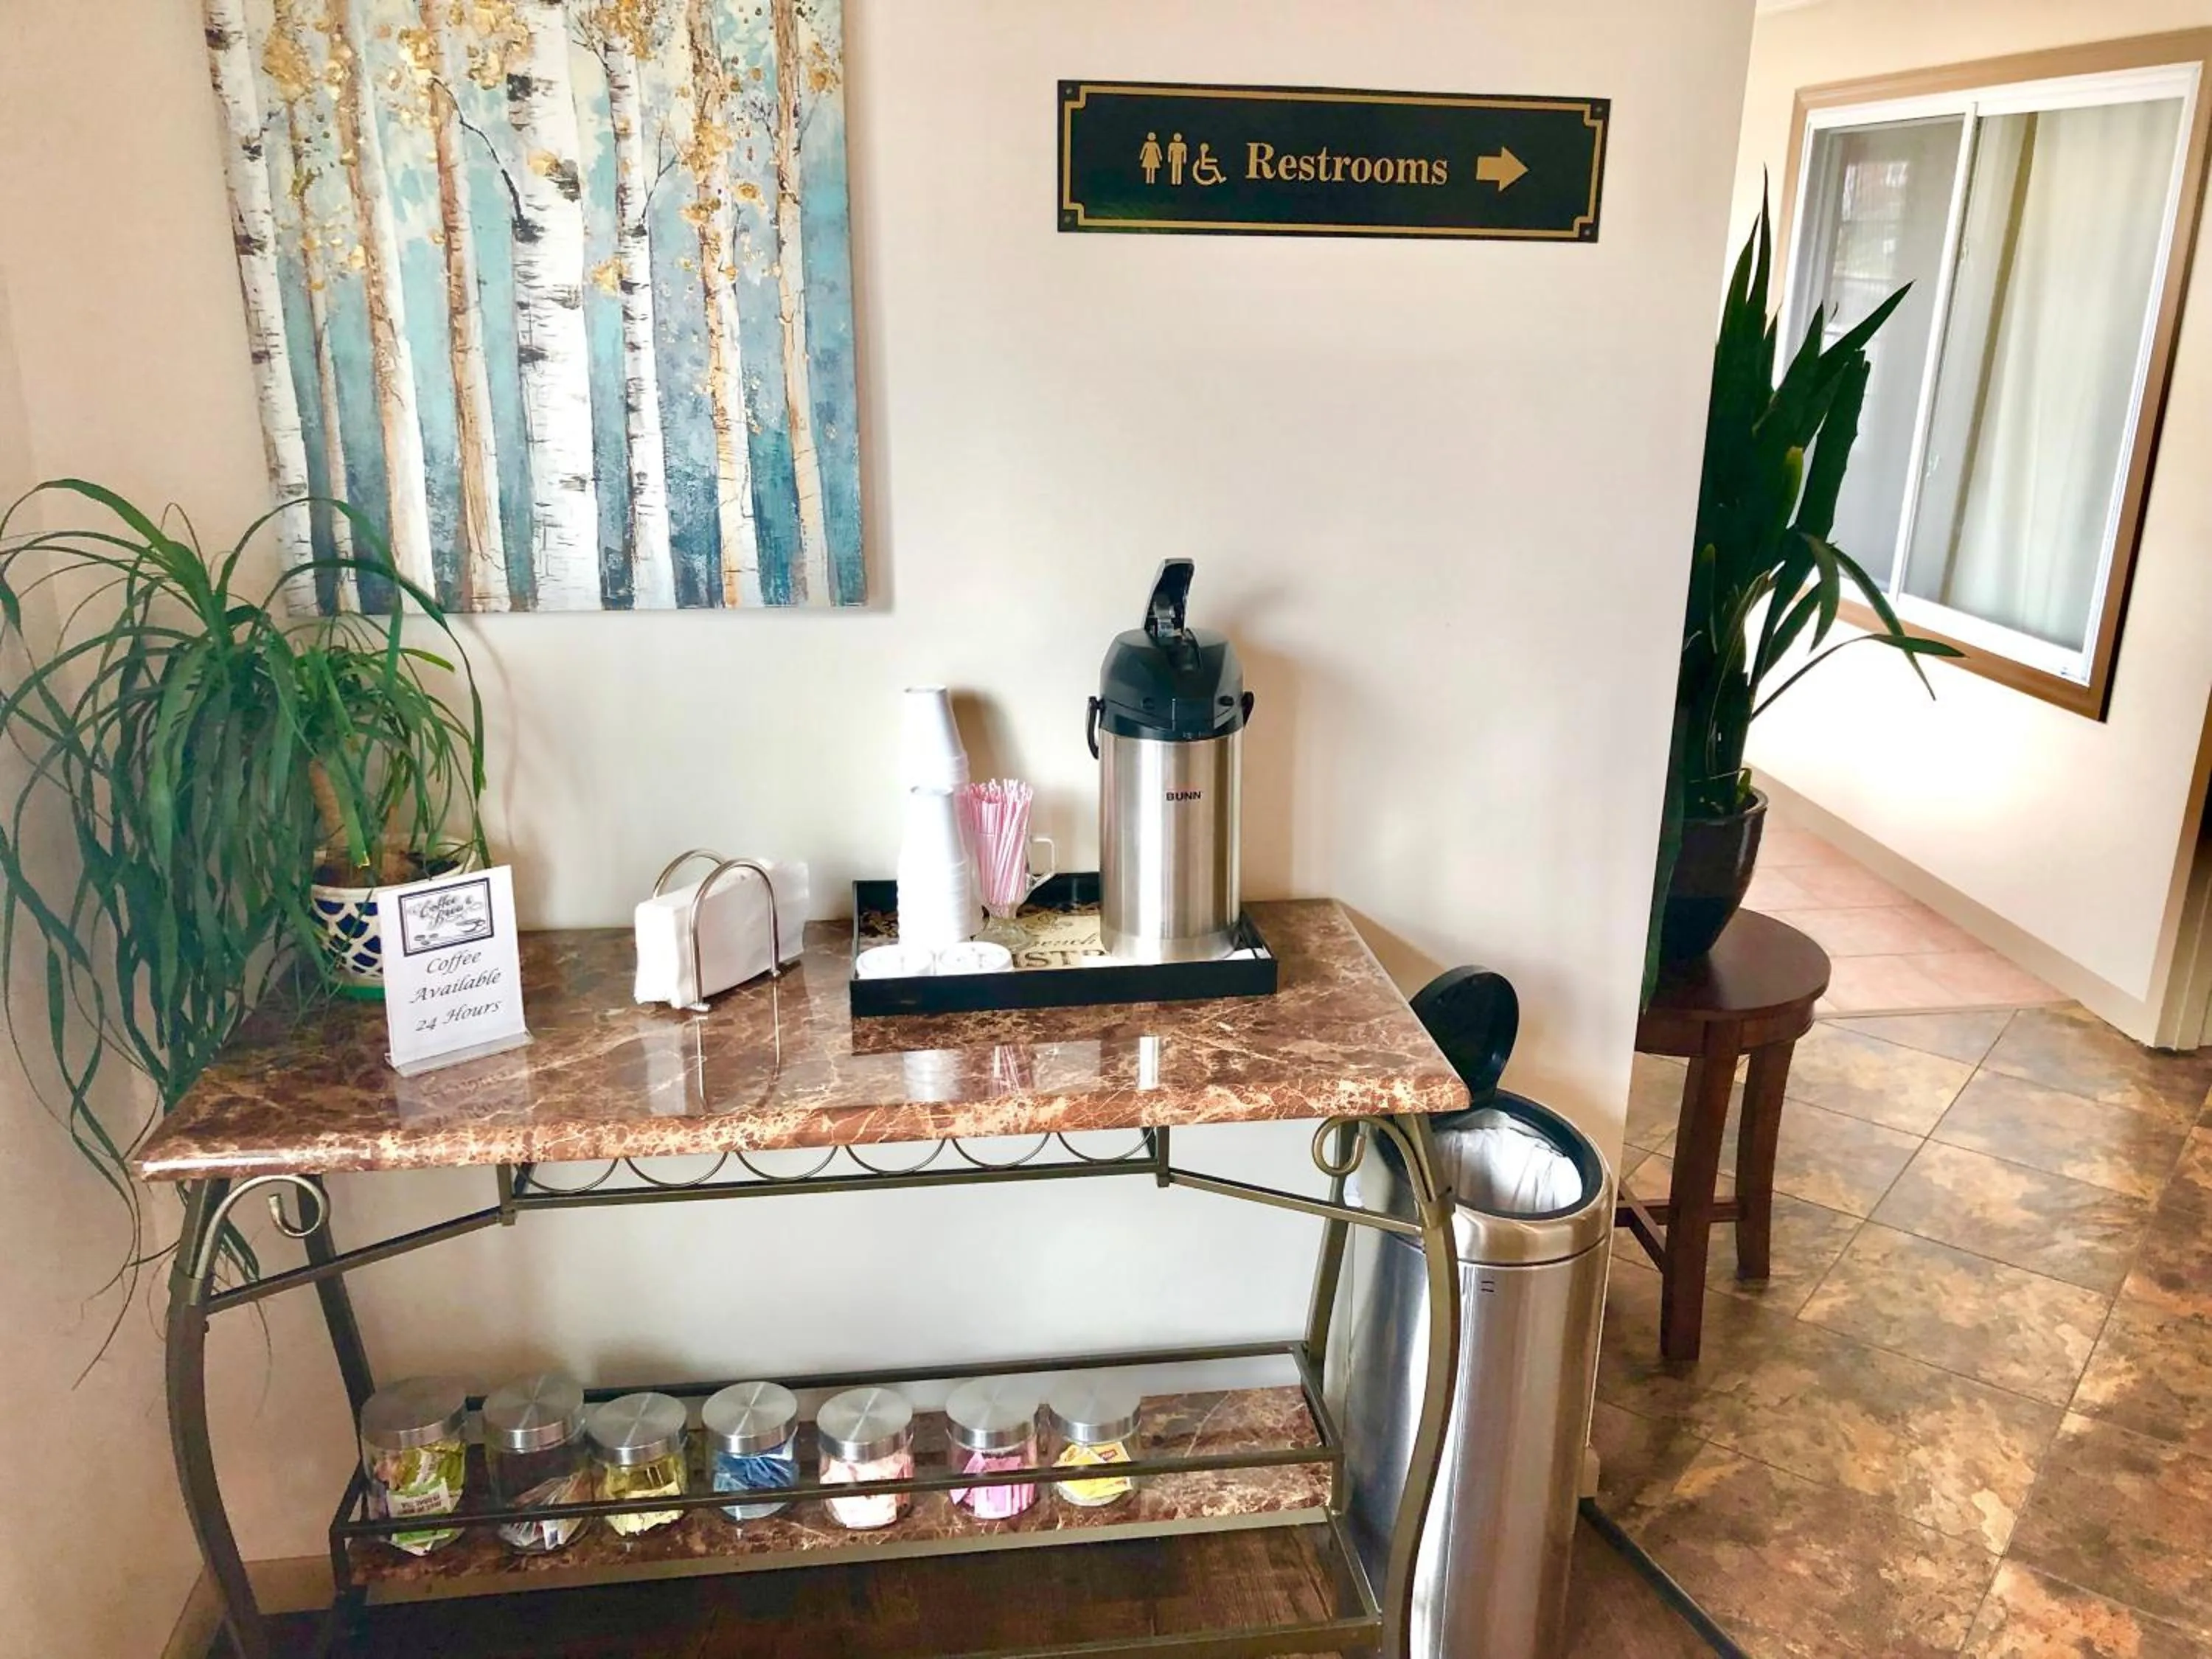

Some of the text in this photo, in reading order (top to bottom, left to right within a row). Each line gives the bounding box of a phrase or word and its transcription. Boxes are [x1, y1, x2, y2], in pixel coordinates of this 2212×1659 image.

[1245, 142, 1448, 186] Restrooms
[1166, 791, 1202, 801] BUNN
[427, 950, 482, 975] Coffee
[409, 967, 502, 1004] Available
[415, 999, 503, 1032] 24 Hours
